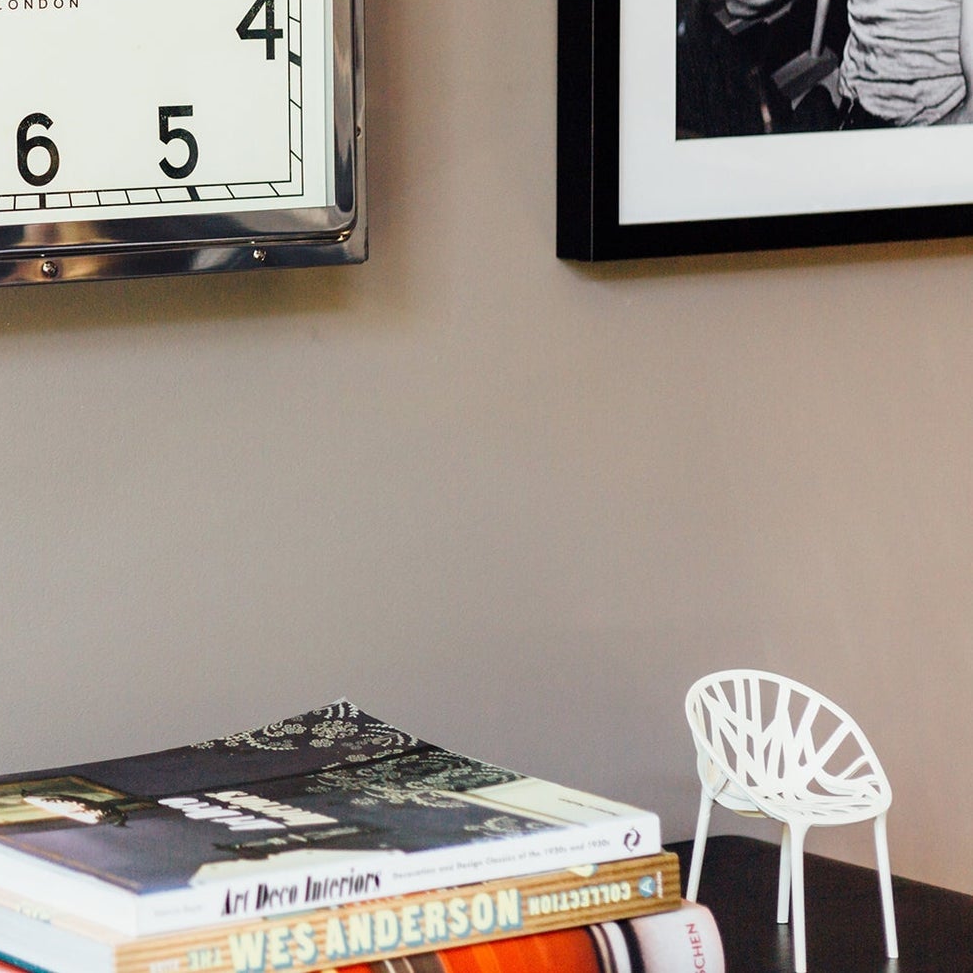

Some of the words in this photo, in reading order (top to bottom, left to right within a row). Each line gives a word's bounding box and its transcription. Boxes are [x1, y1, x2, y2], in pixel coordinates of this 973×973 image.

[16, 112, 60, 187] 6
[158, 104, 199, 180] 5
[456, 858, 483, 871] Design
[529, 850, 541, 860] the
[221, 887, 249, 917] Art
[255, 883, 298, 910] Deco
[305, 866, 381, 903] Interiors
[529, 880, 632, 916] COLLECTION
[228, 921, 318, 973] WES
[325, 888, 522, 961] ANDERSON
[186, 945, 225, 971] THE
